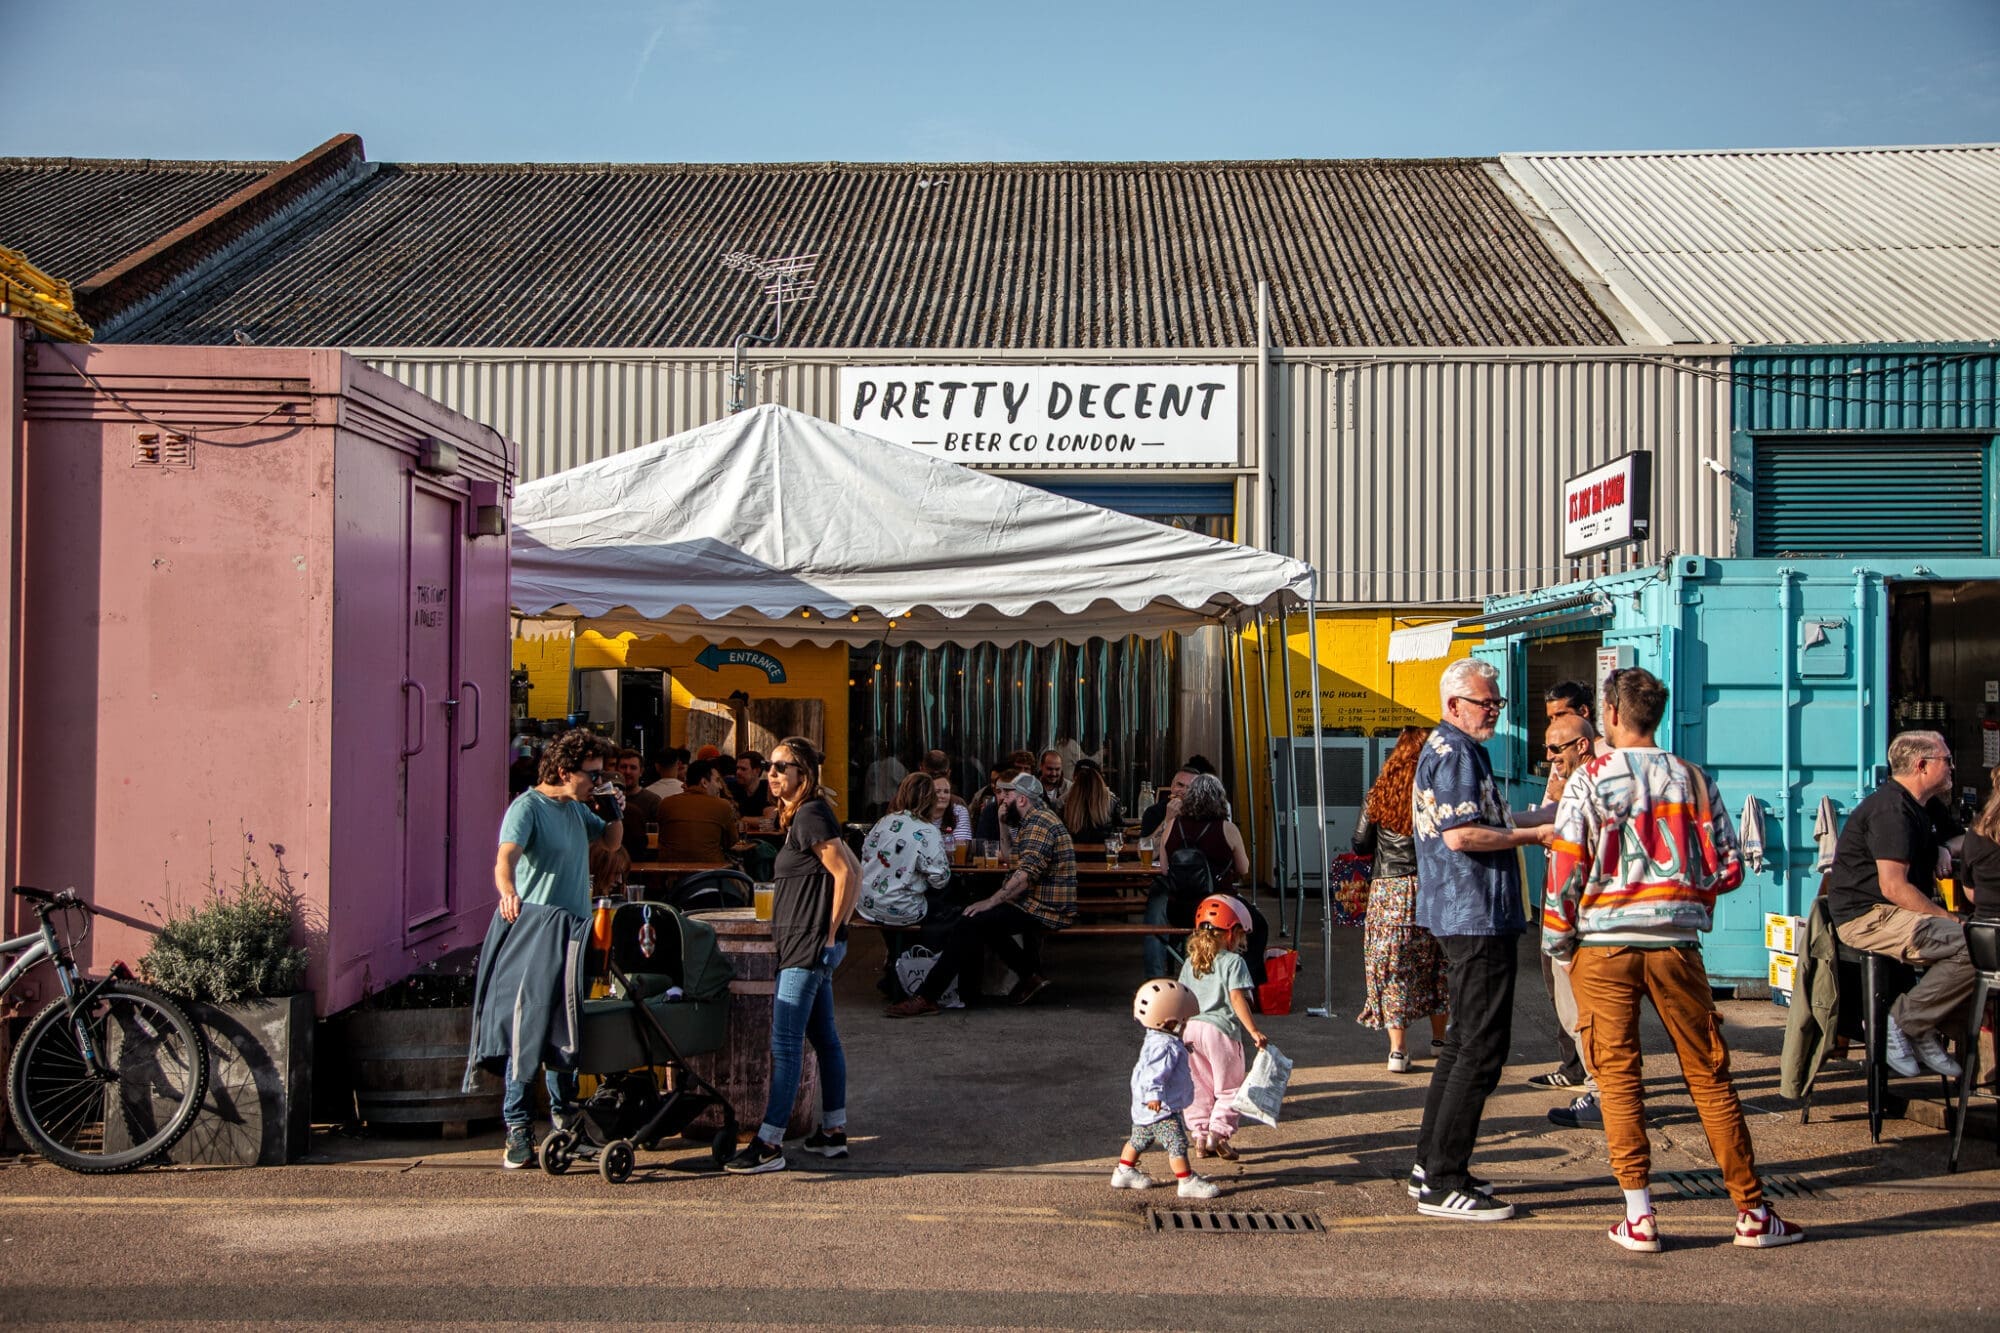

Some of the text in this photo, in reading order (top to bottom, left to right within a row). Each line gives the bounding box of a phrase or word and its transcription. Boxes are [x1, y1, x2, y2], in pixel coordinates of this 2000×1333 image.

[852, 380, 1226, 424] PRETTY DECENT
[944, 432, 1136, 452] BEER CO LONDON
[729, 652, 781, 677] ENTRANCE
[1294, 690, 1335, 699] OPEING
